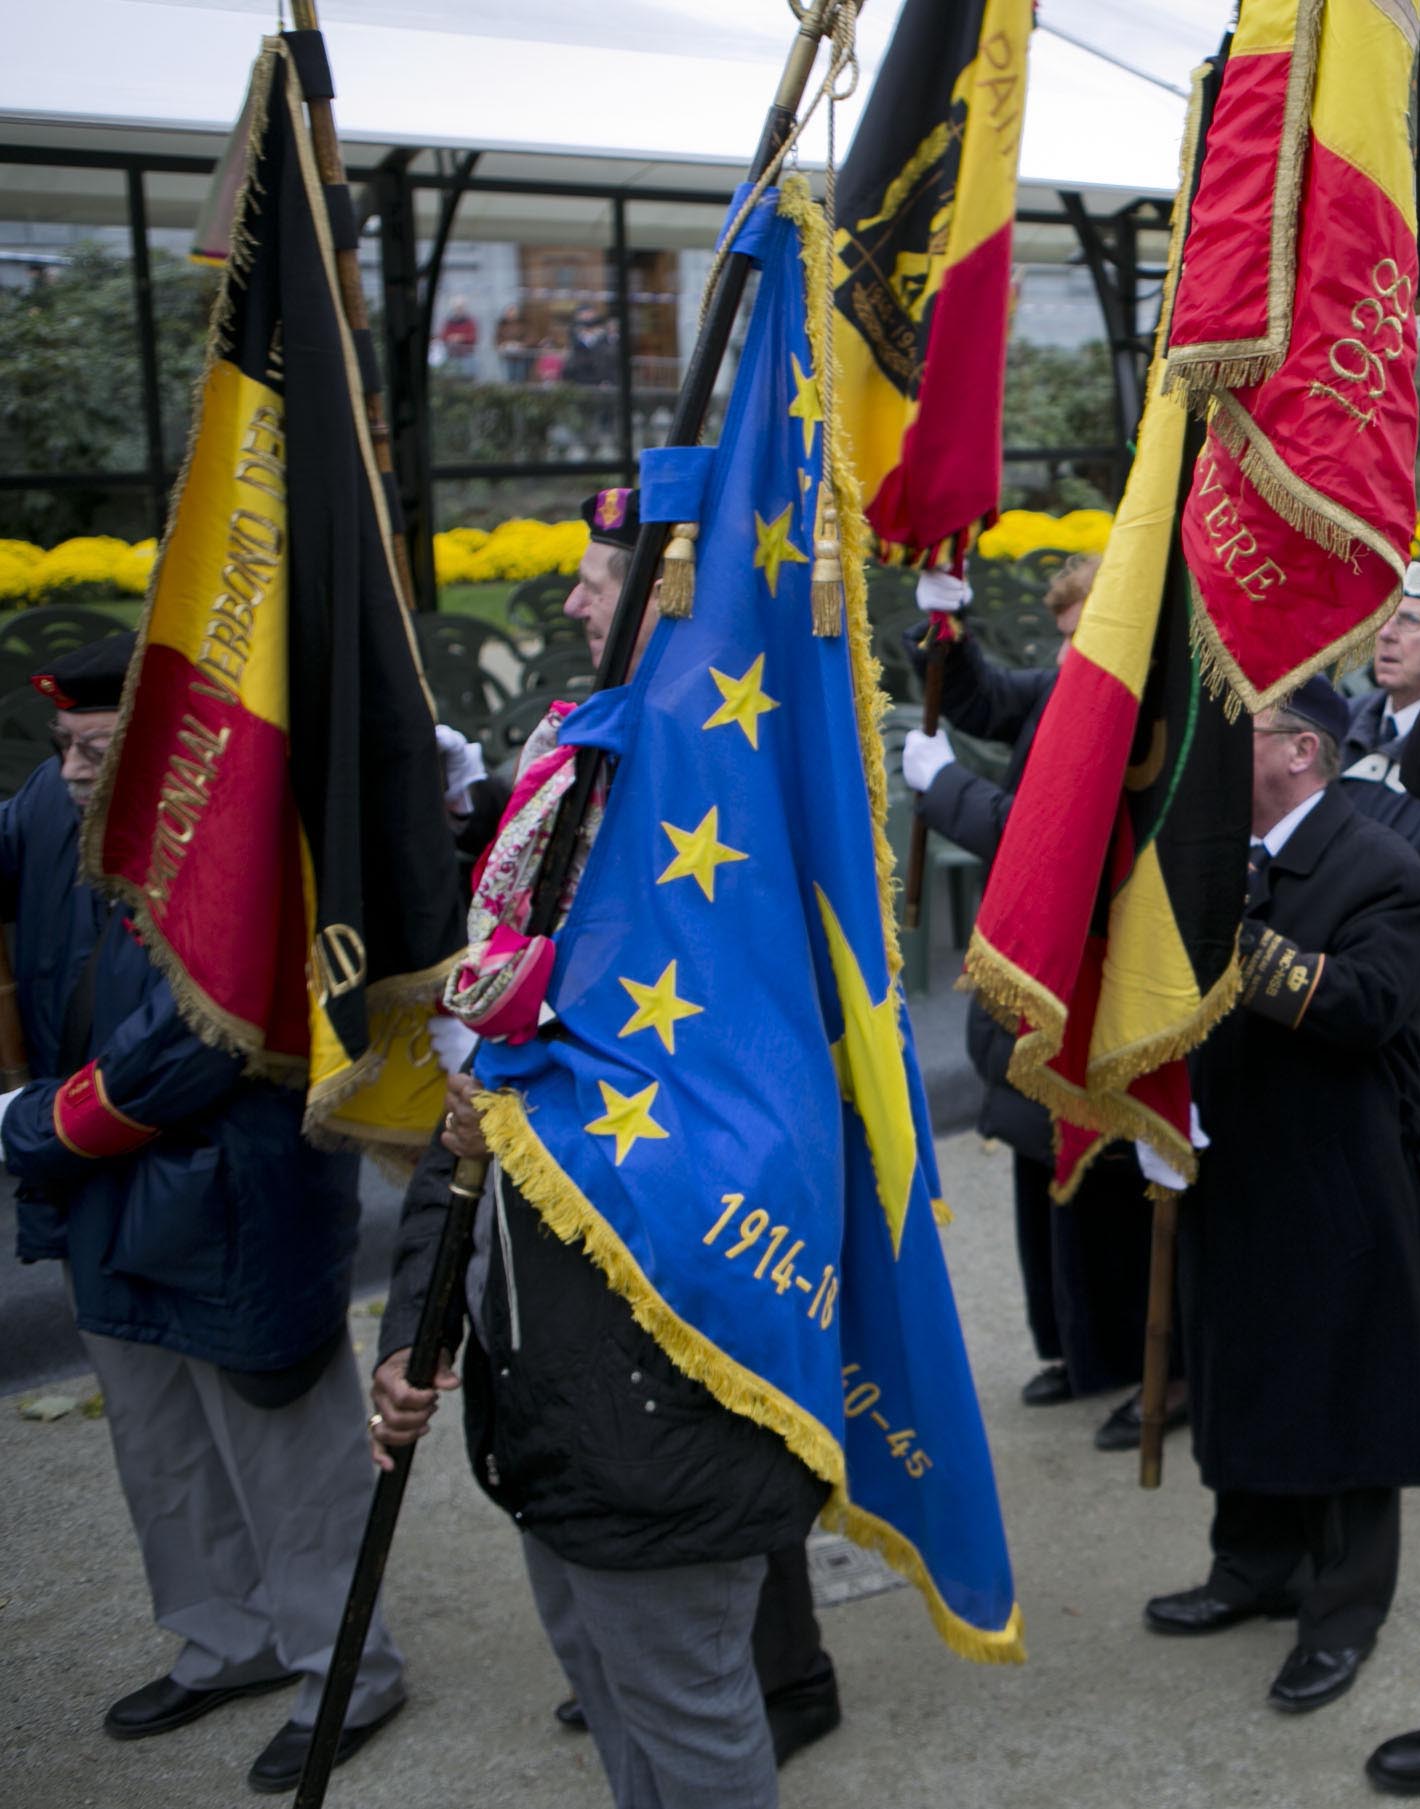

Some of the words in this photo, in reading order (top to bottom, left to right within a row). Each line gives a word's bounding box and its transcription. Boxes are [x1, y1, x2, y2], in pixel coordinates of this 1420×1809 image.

[1310, 258, 1412, 433] 1938
[189, 509, 283, 706] VERBOND
[1199, 455, 1287, 602] VERE
[702, 1192, 840, 1331] 1914-18
